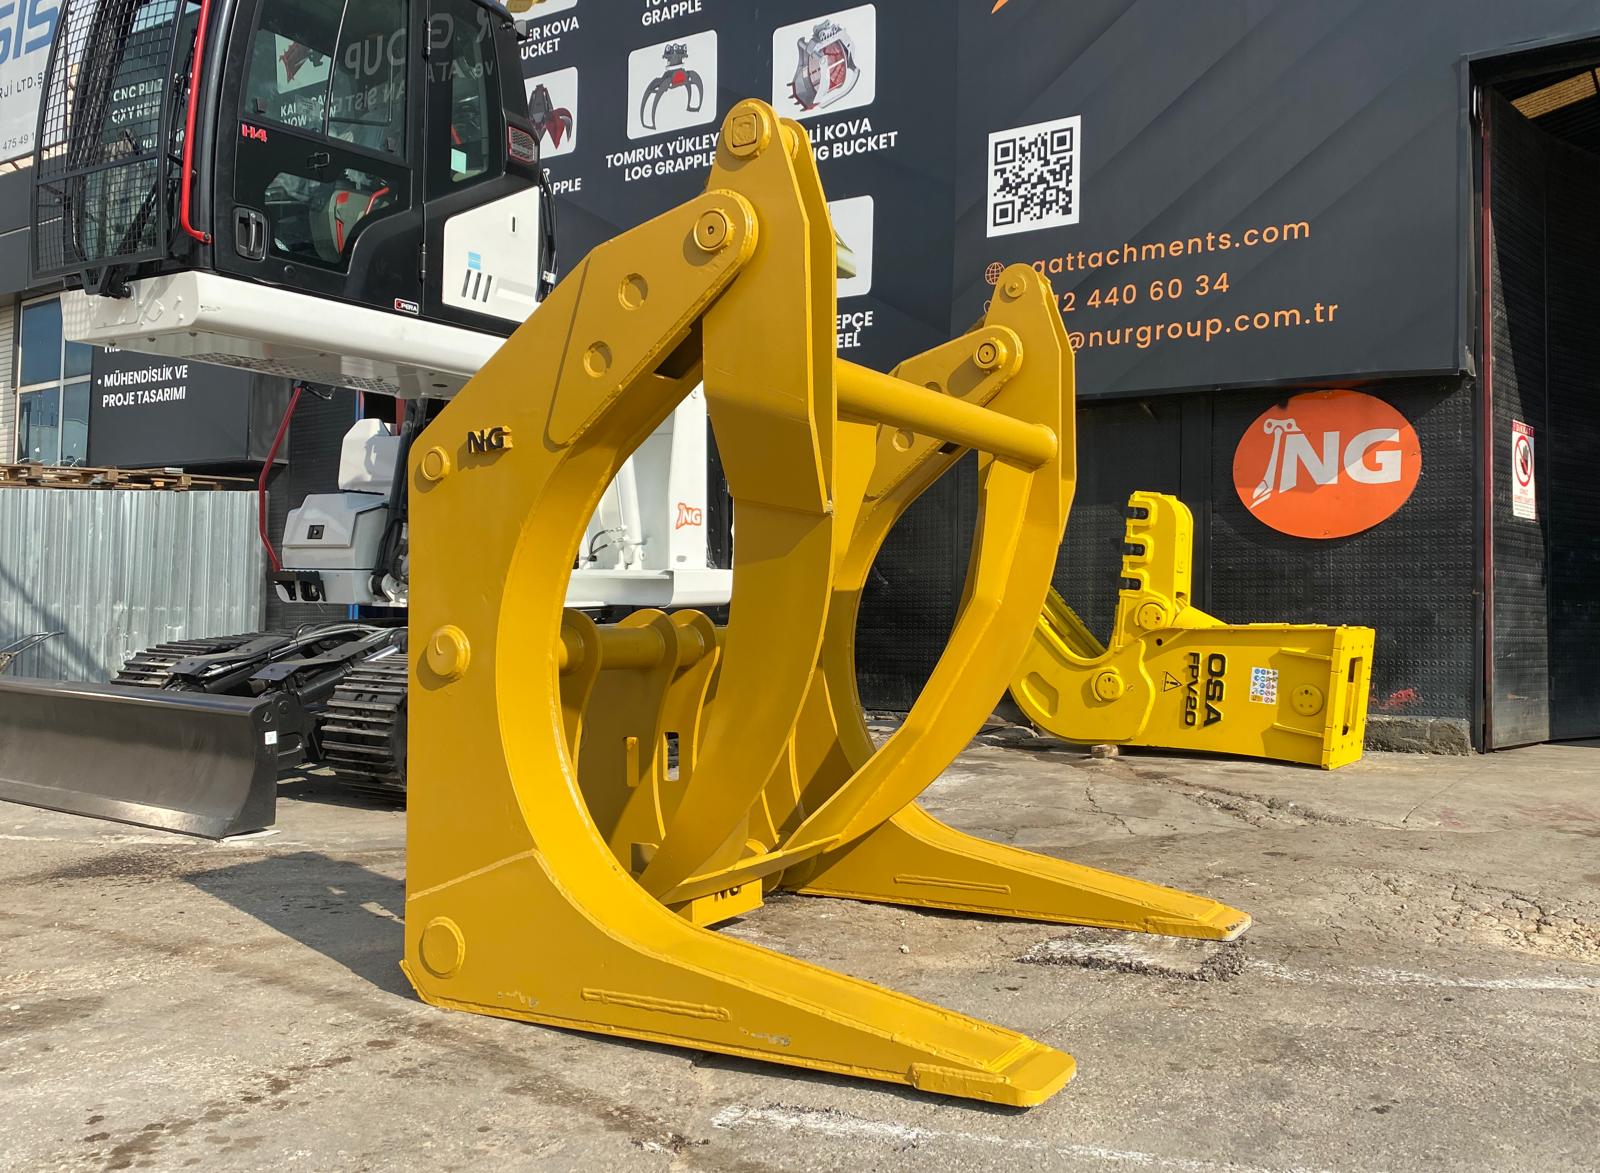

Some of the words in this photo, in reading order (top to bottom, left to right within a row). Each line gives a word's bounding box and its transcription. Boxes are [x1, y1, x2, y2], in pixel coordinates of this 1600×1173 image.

[642, 0, 702, 26] GRAPPLE
[543, 16, 579, 38] KOVA
[521, 38, 560, 60] UCKET
[17, 72, 43, 93] LTD.Ş
[113, 85, 136, 102] CNC
[241, 124, 268, 143] H4
[824, 117, 872, 141] KOVA
[606, 144, 664, 168] TOMRUK
[667, 132, 720, 156] YÜKLEY
[833, 131, 898, 158] BUCKET
[625, 164, 652, 182] LOG
[655, 151, 716, 176] GRAPPLE
[1032, 221, 1310, 276] gattachments.com
[1086, 284, 1137, 309] 440
[1150, 277, 1183, 299] 60
[1195, 272, 1230, 296] 34
[836, 310, 874, 333] EPÇE
[1068, 301, 1339, 353] @nurgroup.com.tr
[836, 332, 861, 349] EEL
[104, 364, 173, 388] MÜHENDİSLİK
[175, 364, 188, 379] VE
[103, 391, 136, 408] PROJE
[137, 386, 186, 404] TASARIMI
[467, 425, 512, 454] NG
[1279, 427, 1403, 494] NG
[1185, 652, 1201, 727] FPV20
[1203, 653, 1227, 728] OSA
